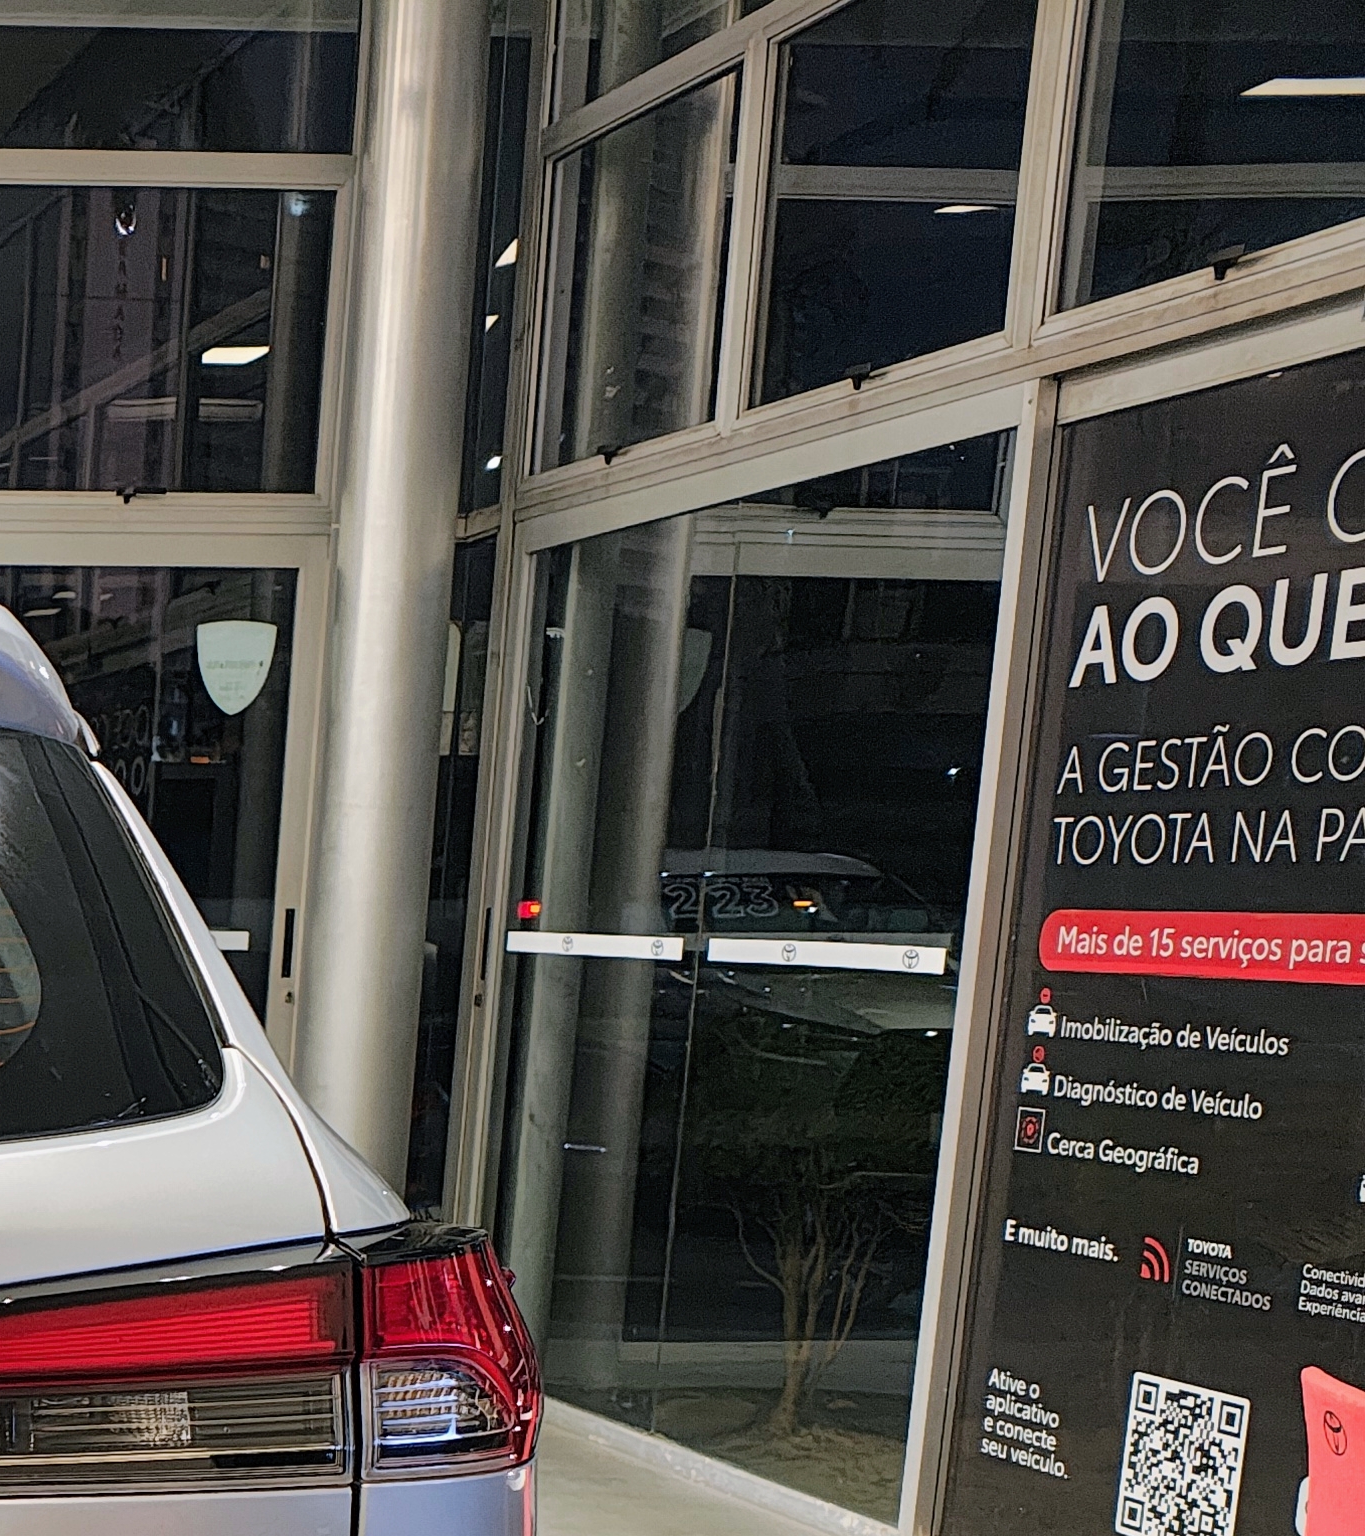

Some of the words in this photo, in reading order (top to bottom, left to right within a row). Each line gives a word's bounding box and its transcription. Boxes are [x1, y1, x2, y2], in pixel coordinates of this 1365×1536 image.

[1087, 443, 1298, 583] VOCÊ
[1068, 596, 1179, 688] AO
[1200, 566, 1365, 674] QUE
[1056, 745, 1084, 795] A
[1098, 724, 1273, 793] GESTÃO
[1291, 725, 1365, 783] CO
[1053, 812, 1215, 865] TOYOTA
[1231, 809, 1297, 864] NA
[1316, 807, 1365, 863] PA
[1057, 925, 1109, 955] Mais
[1113, 925, 1143, 956] de
[1149, 928, 1176, 958] 15
[1180, 930, 1283, 968] serviços
[1289, 938, 1351, 970] para
[1060, 1015, 1173, 1050] Imobilização
[1176, 1023, 1202, 1049] de
[1206, 1025, 1290, 1056] Veículos
[1054, 1074, 1158, 1107] Diagnóstico
[1161, 1085, 1187, 1111] de
[1191, 1088, 1263, 1120] Veículo
[1047, 1131, 1095, 1160] Cerca
[1098, 1138, 1200, 1175] Geográfica
[1004, 1218, 1017, 1242] E
[1018, 1225, 1069, 1252] muito
[1071, 1235, 1119, 1262] mais.
[1187, 1237, 1233, 1259] TOYOTA
[1183, 1259, 1248, 1285] SERVIÇOS
[1300, 1280, 1339, 1300] Dados
[1302, 1263, 1365, 1288] Conectivid
[1181, 1279, 1272, 1311] CONECTADOS
[988, 1368, 1027, 1396] Ative
[1029, 1383, 1040, 1399] o
[986, 1393, 1060, 1428] aplicativo
[984, 1416, 994, 1432] e
[996, 1420, 1057, 1451] conecte
[980, 1437, 1008, 1460] seu
[1010, 1447, 1069, 1479] veículo.
